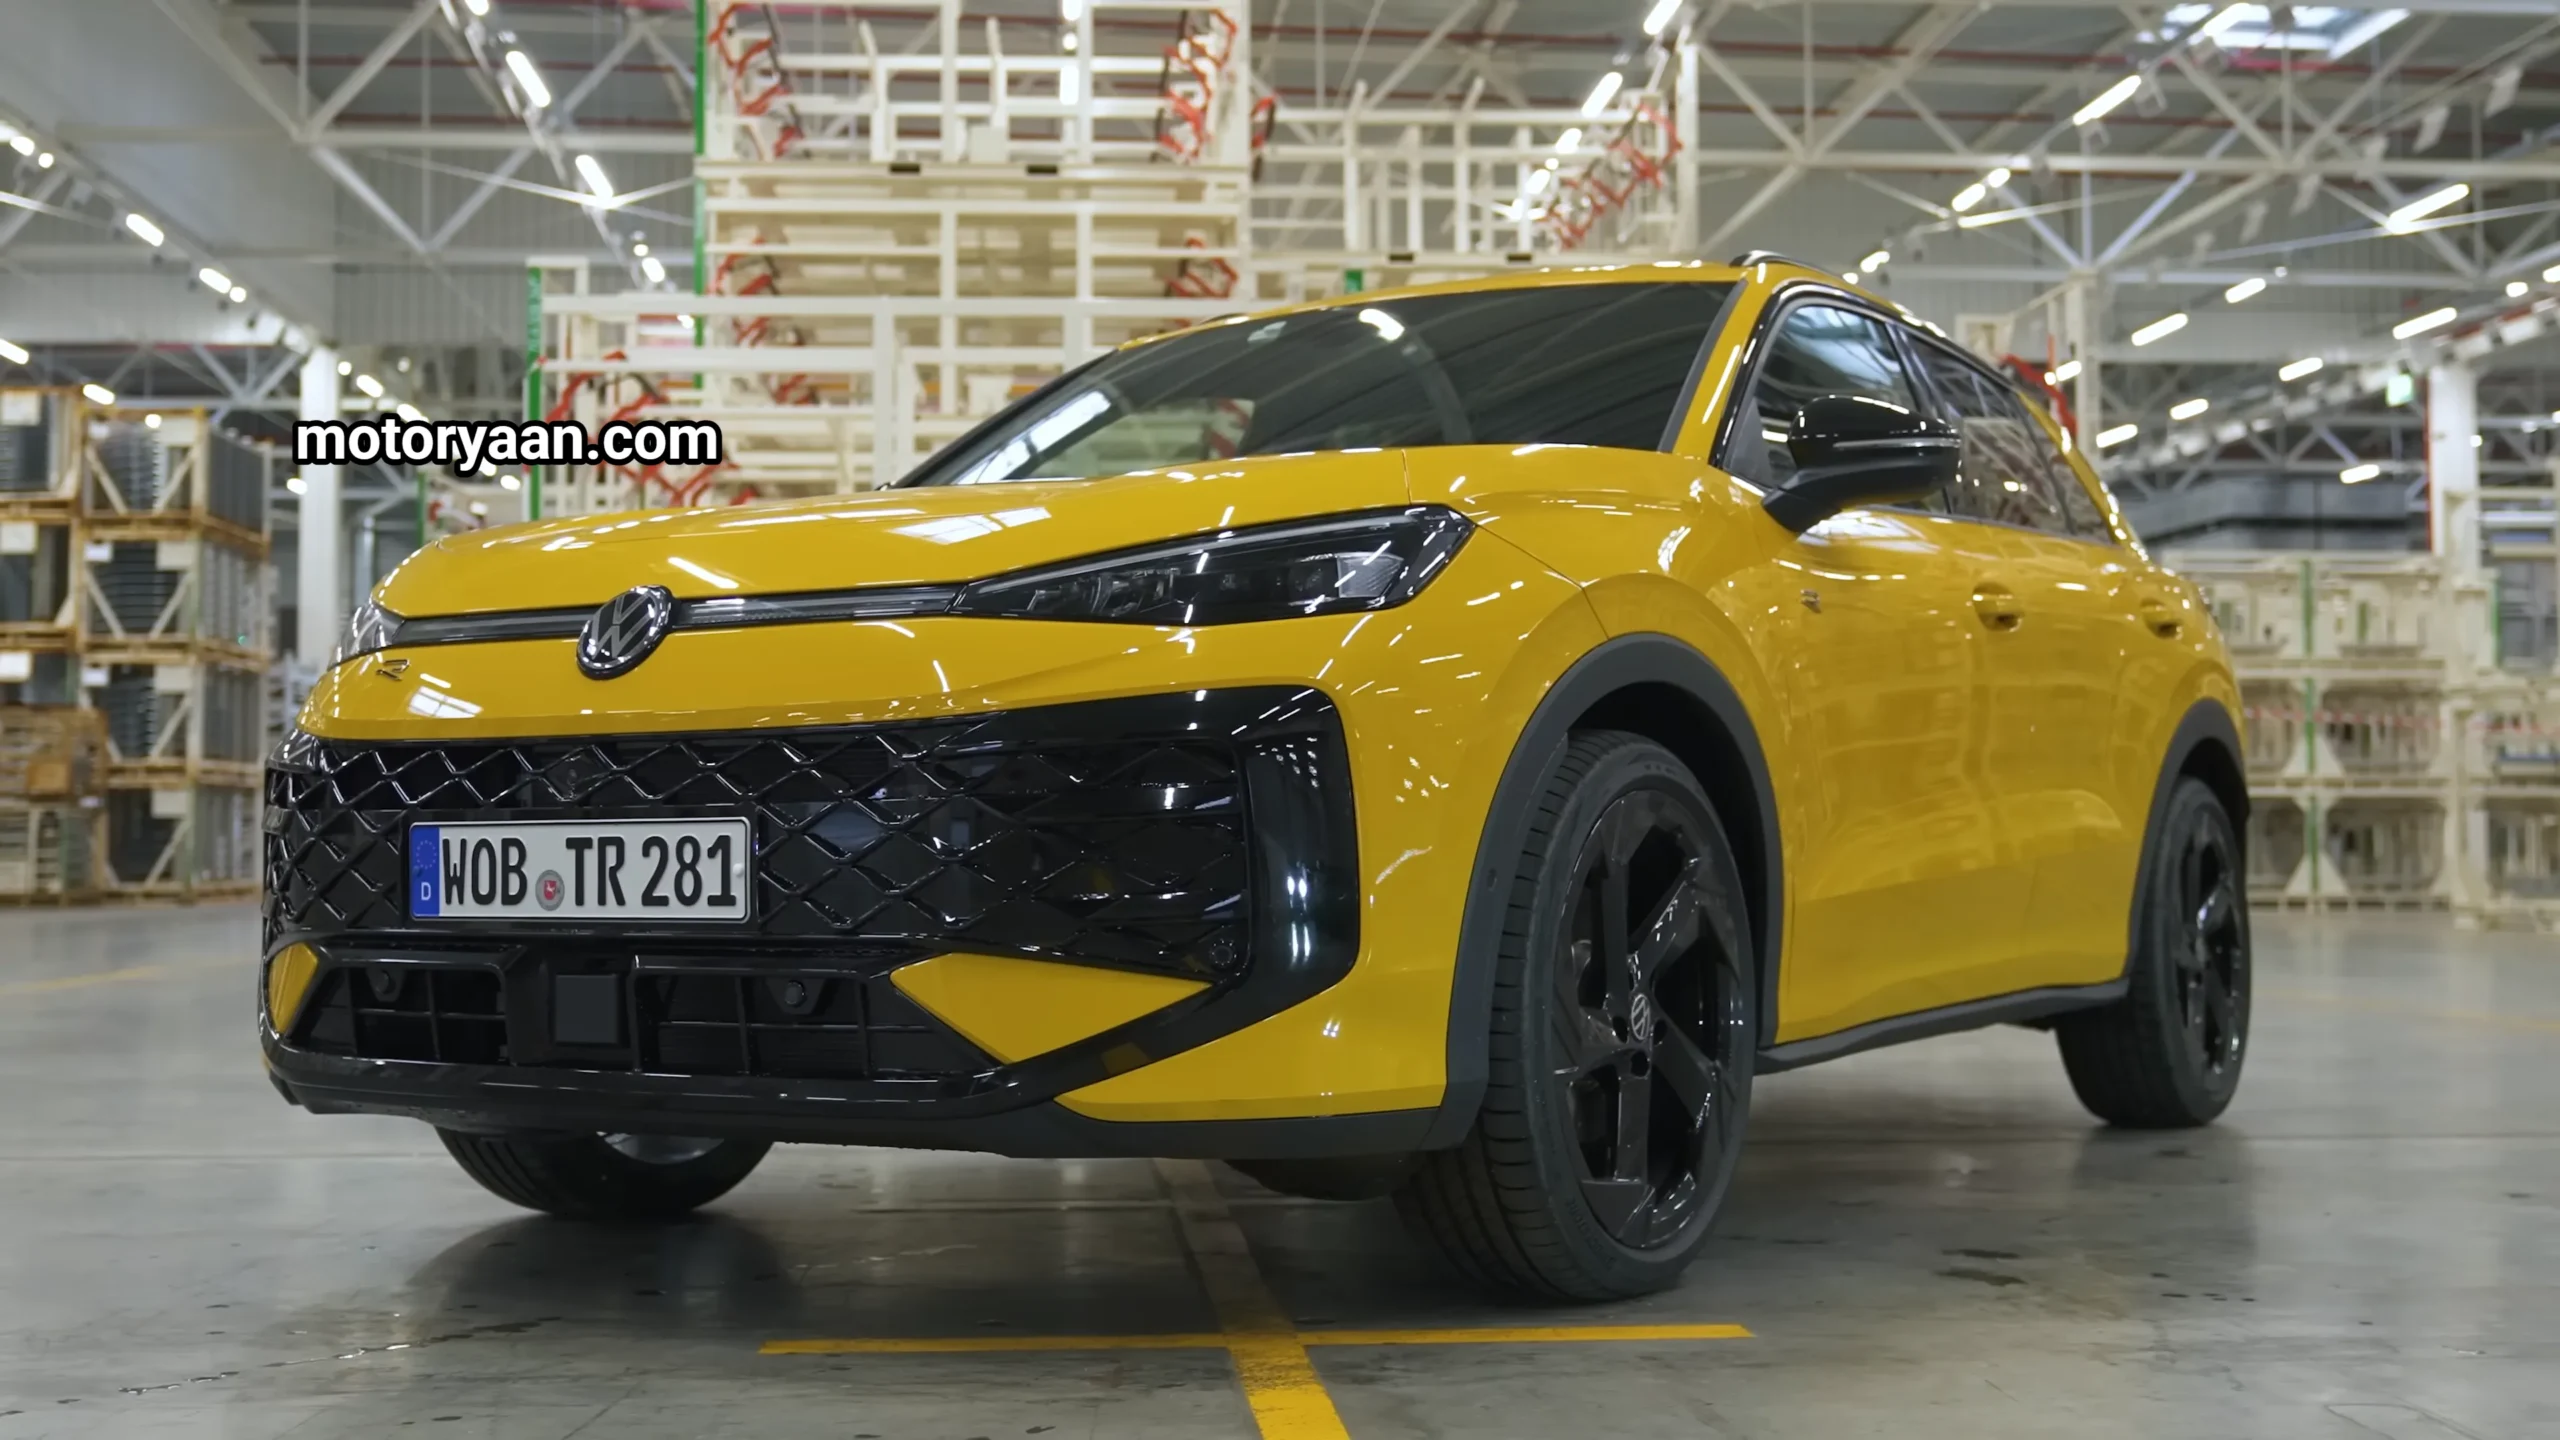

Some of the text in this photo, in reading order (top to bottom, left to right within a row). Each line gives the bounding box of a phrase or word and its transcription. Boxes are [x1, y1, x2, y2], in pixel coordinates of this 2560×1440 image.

[420, 881, 433, 901] D
[442, 834, 737, 907] WOB TR 281
